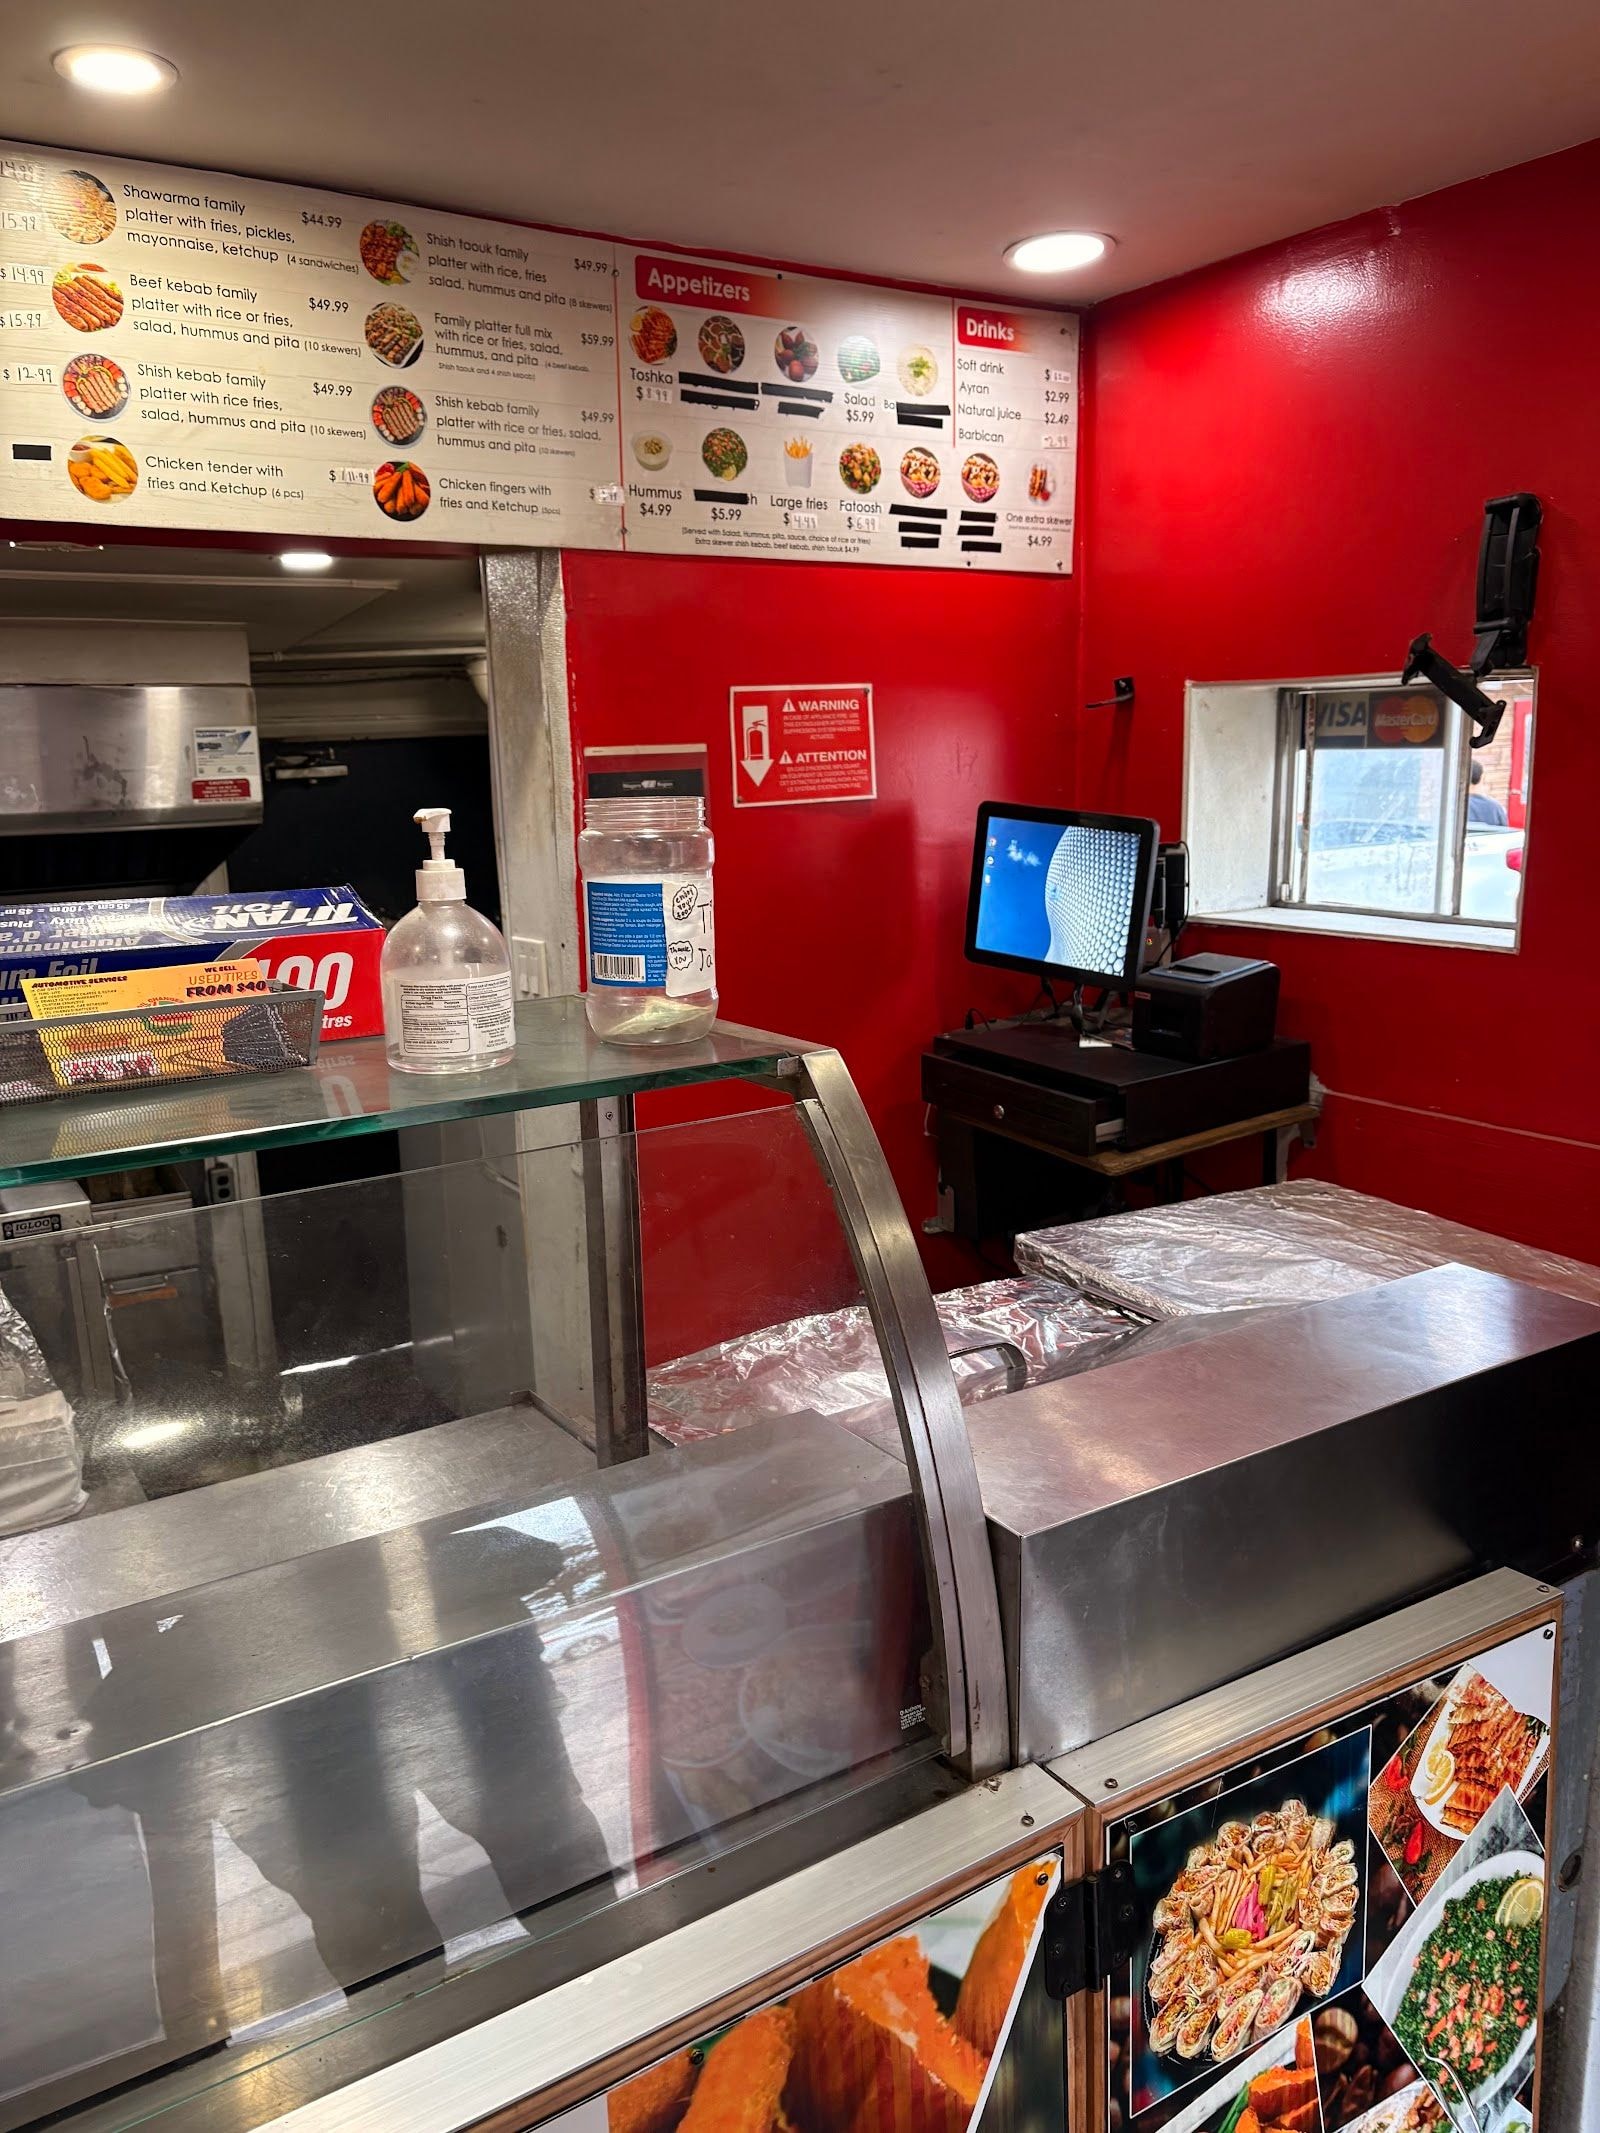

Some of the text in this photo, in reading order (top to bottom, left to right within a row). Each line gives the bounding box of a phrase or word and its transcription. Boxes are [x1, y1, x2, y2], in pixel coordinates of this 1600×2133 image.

[124, 185, 245, 216] Shawarma family
[126, 208, 294, 243] platter with fries, pickles,
[302, 212, 342, 228] $44.99
[128, 232, 358, 274] mayonnaise, ketchup (4 sandwiches)
[427, 233, 528, 263] Shish taouk family
[428, 255, 546, 283] platter with rice, fries
[574, 258, 608, 273] $49.99
[0, 267, 44, 285] $ 14.99
[130, 274, 257, 303] Beef kebab family
[468, 280, 516, 297] hummus
[518, 290, 541, 301] and
[544, 293, 566, 305] pita
[648, 268, 750, 301] Appetizers
[132, 297, 292, 327] platter with rice or fries,
[309, 297, 348, 312] $49.99
[0, 314, 40, 328] $ 15.99
[435, 313, 552, 339] Family platter full mix
[967, 318, 1013, 340] Drinks
[134, 320, 361, 357] salad, hummus and pita (10 skewers)
[435, 329, 459, 341] with
[462, 332, 484, 344] rice
[487, 338, 498, 346] or
[502, 336, 527, 350] fries,
[581, 333, 614, 346] $59.99
[436, 343, 538, 366] hummus, and pita
[957, 358, 1004, 374] Soft drink
[4, 367, 52, 383] $ 12.99
[138, 364, 266, 390] Shish kebab family
[630, 368, 673, 384] Toshka
[313, 382, 352, 396] $49.99
[960, 382, 989, 395] Ayran
[1045, 390, 1069, 402] $2.99
[140, 386, 282, 411] platter with rice fries,
[844, 392, 875, 406] Salad
[436, 396, 539, 418] Shish kebab family
[958, 404, 1021, 420] Natural juice
[582, 410, 614, 423] $49.99
[846, 409, 874, 422] $5.99
[1045, 412, 1068, 424] $2.49
[142, 409, 366, 440] salad, hummus and pita (10 skewers)
[437, 416, 475, 428] platter
[478, 420, 501, 431] with
[504, 424, 524, 433] rice
[528, 426, 539, 434] or
[542, 424, 566, 437] fries,
[959, 428, 1004, 442] Barbican
[437, 434, 536, 453] hummus and pita
[146, 456, 283, 476] Chicken tender with
[148, 477, 303, 500] fries and Ketchup (6 pcs)
[439, 478, 551, 495] Chicken fingers with
[629, 484, 682, 500] Hummus
[440, 497, 538, 514] fries and Ketchup
[640, 503, 671, 516] $4.99
[771, 496, 828, 510] Large fries
[840, 500, 881, 513] Fatoosh
[712, 508, 741, 521] $5.99
[1006, 513, 1023, 522] One
[1025, 515, 1044, 524] extra
[1028, 535, 1052, 547] $4.99
[798, 700, 859, 711] WARNING
[1315, 701, 1366, 727] VISA
[796, 750, 866, 763] ATTENTION
[212, 900, 292, 915] FOIL
[213, 902, 358, 929] TITAN
[32, 980, 88, 989] AUTOMOTIVE
[189, 971, 257, 985] USED TIRES
[186, 981, 267, 998] FROM $40
[322, 1015, 352, 1028] tres
[16, 1220, 50, 1231] IGLOO
